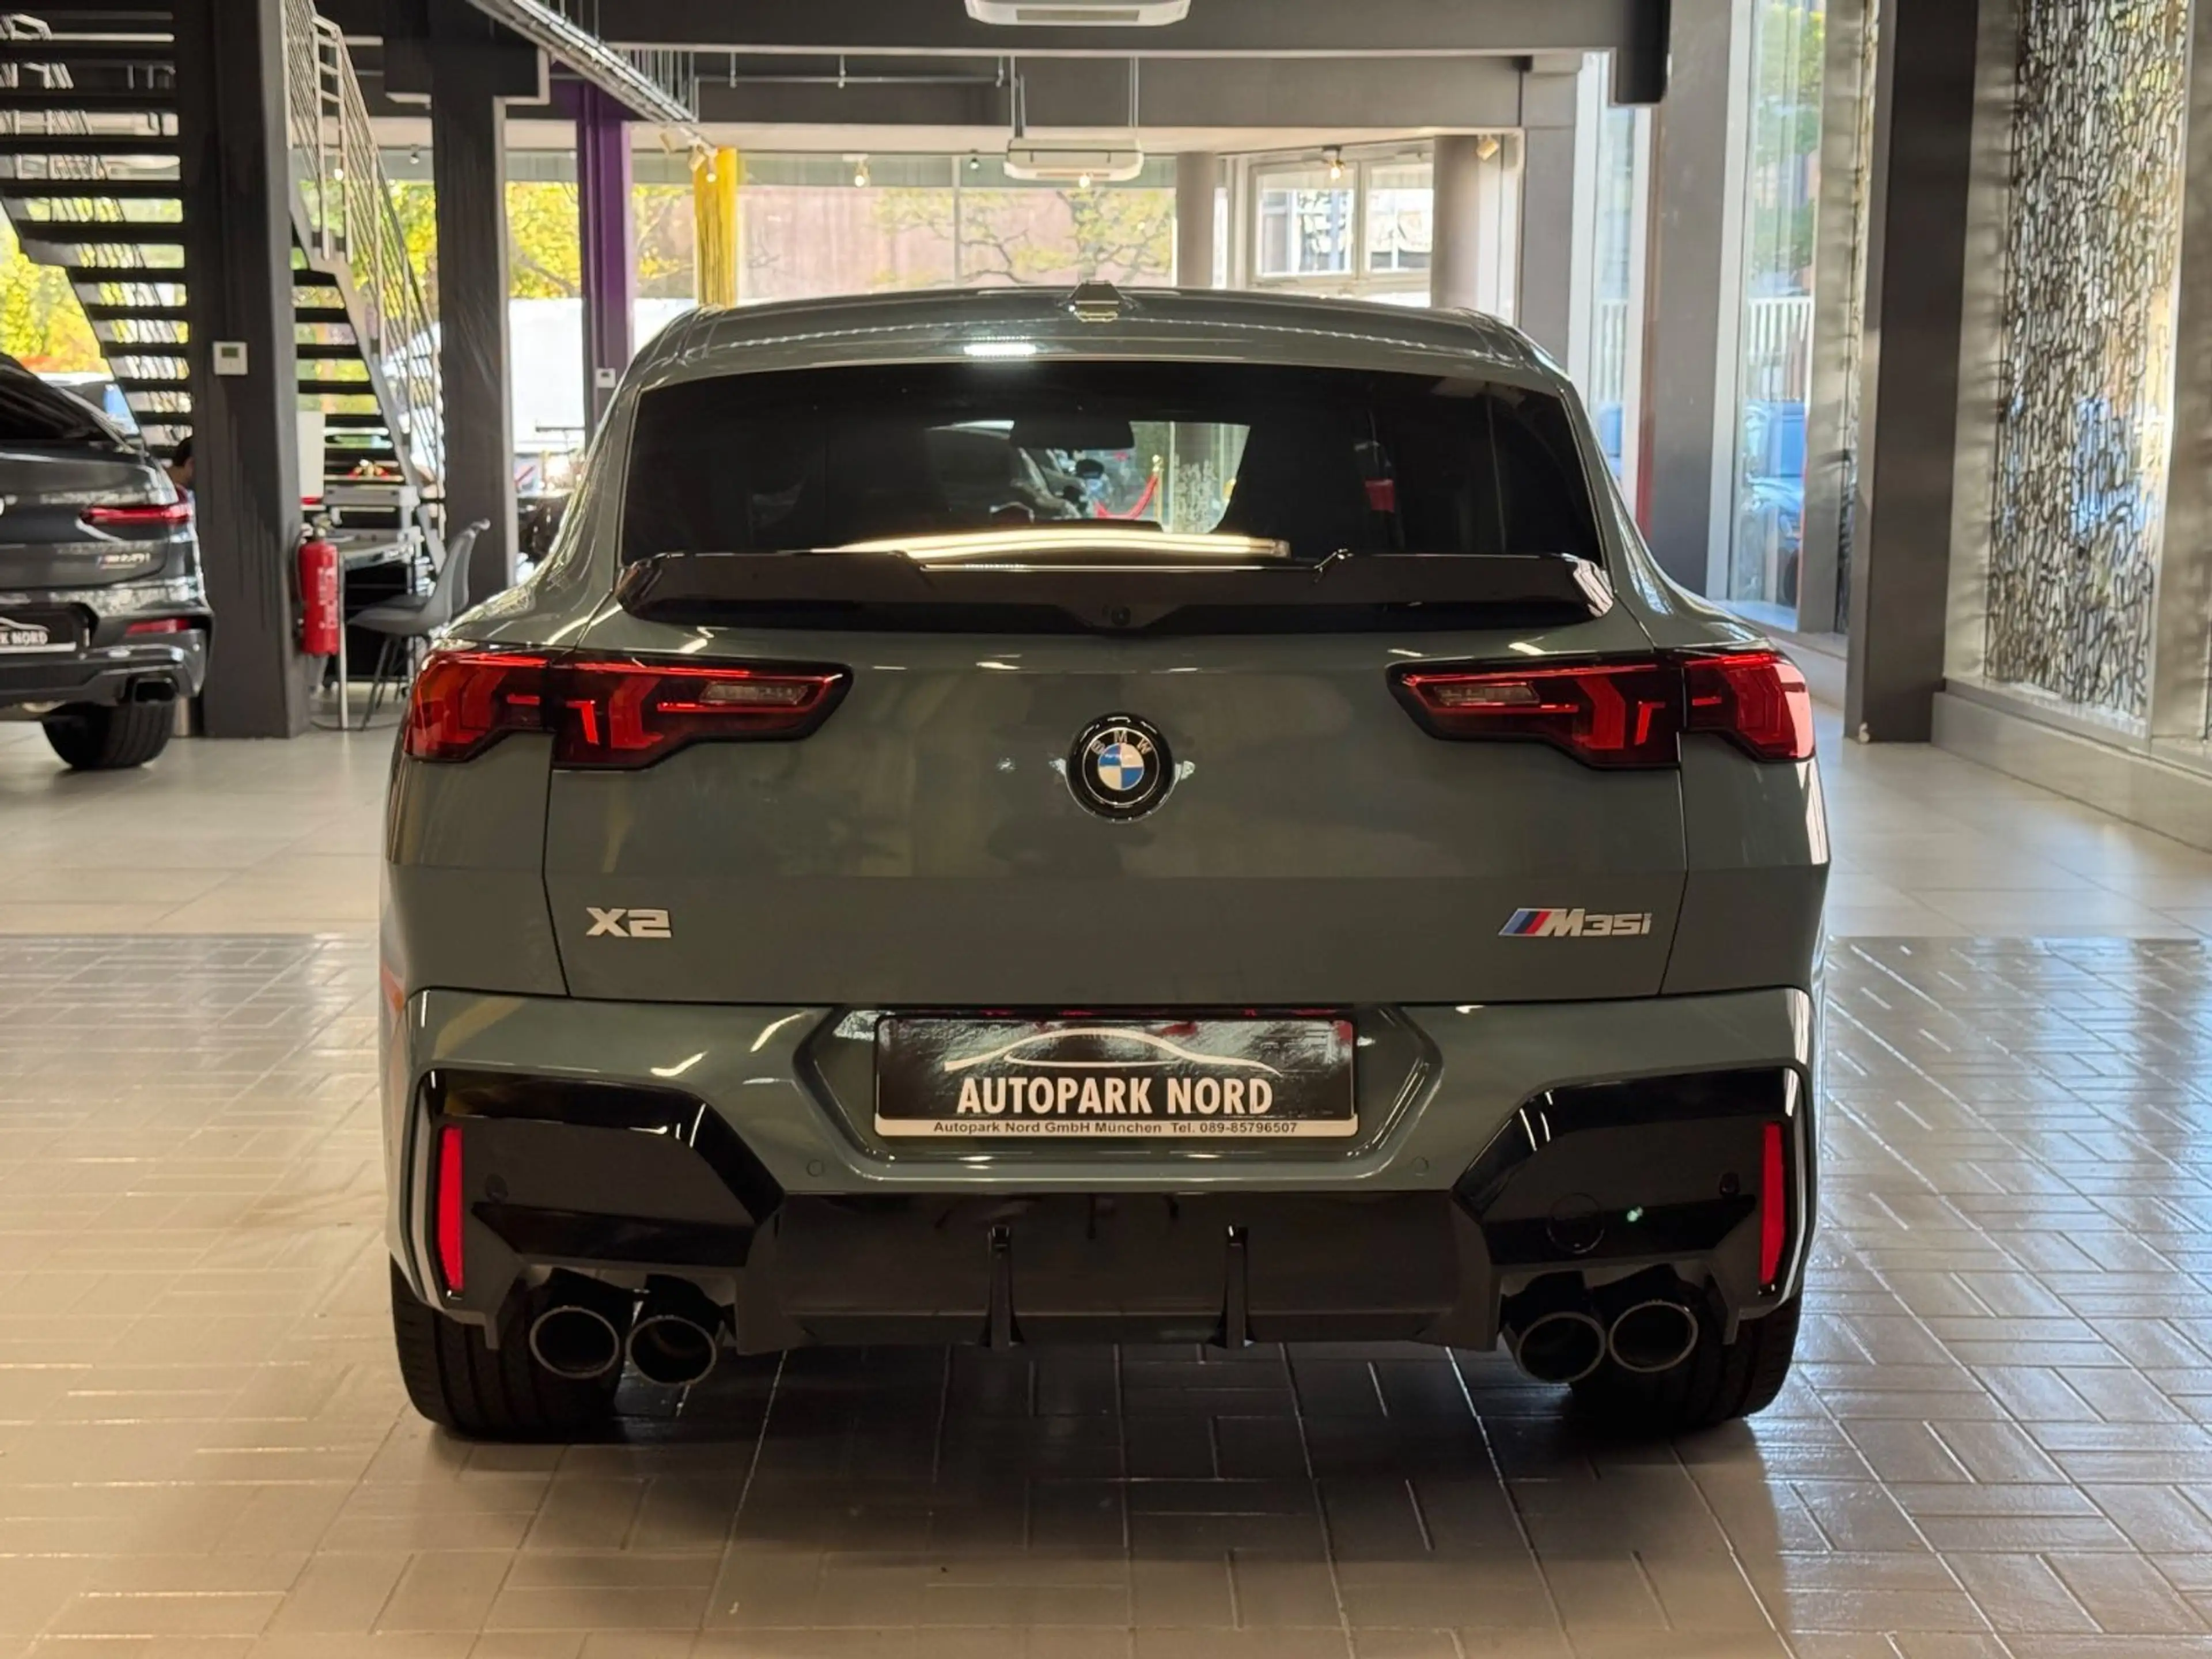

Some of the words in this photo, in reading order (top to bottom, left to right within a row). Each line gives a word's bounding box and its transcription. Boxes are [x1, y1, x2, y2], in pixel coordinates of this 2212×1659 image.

[1090, 729, 1153, 755] BMW
[586, 906, 672, 938] X2
[1533, 908, 1652, 937] M35i
[956, 1077, 1153, 1115] AUTOPARK
[1166, 1077, 1274, 1115] NORD
[933, 1122, 1001, 1134] Autopark
[1005, 1122, 1040, 1133] Nord
[1044, 1122, 1090, 1133] GmbH
[1094, 1121, 1162, 1134] München
[1172, 1122, 1195, 1133] Tel.
[1199, 1122, 1298, 1134] 089-85796507
